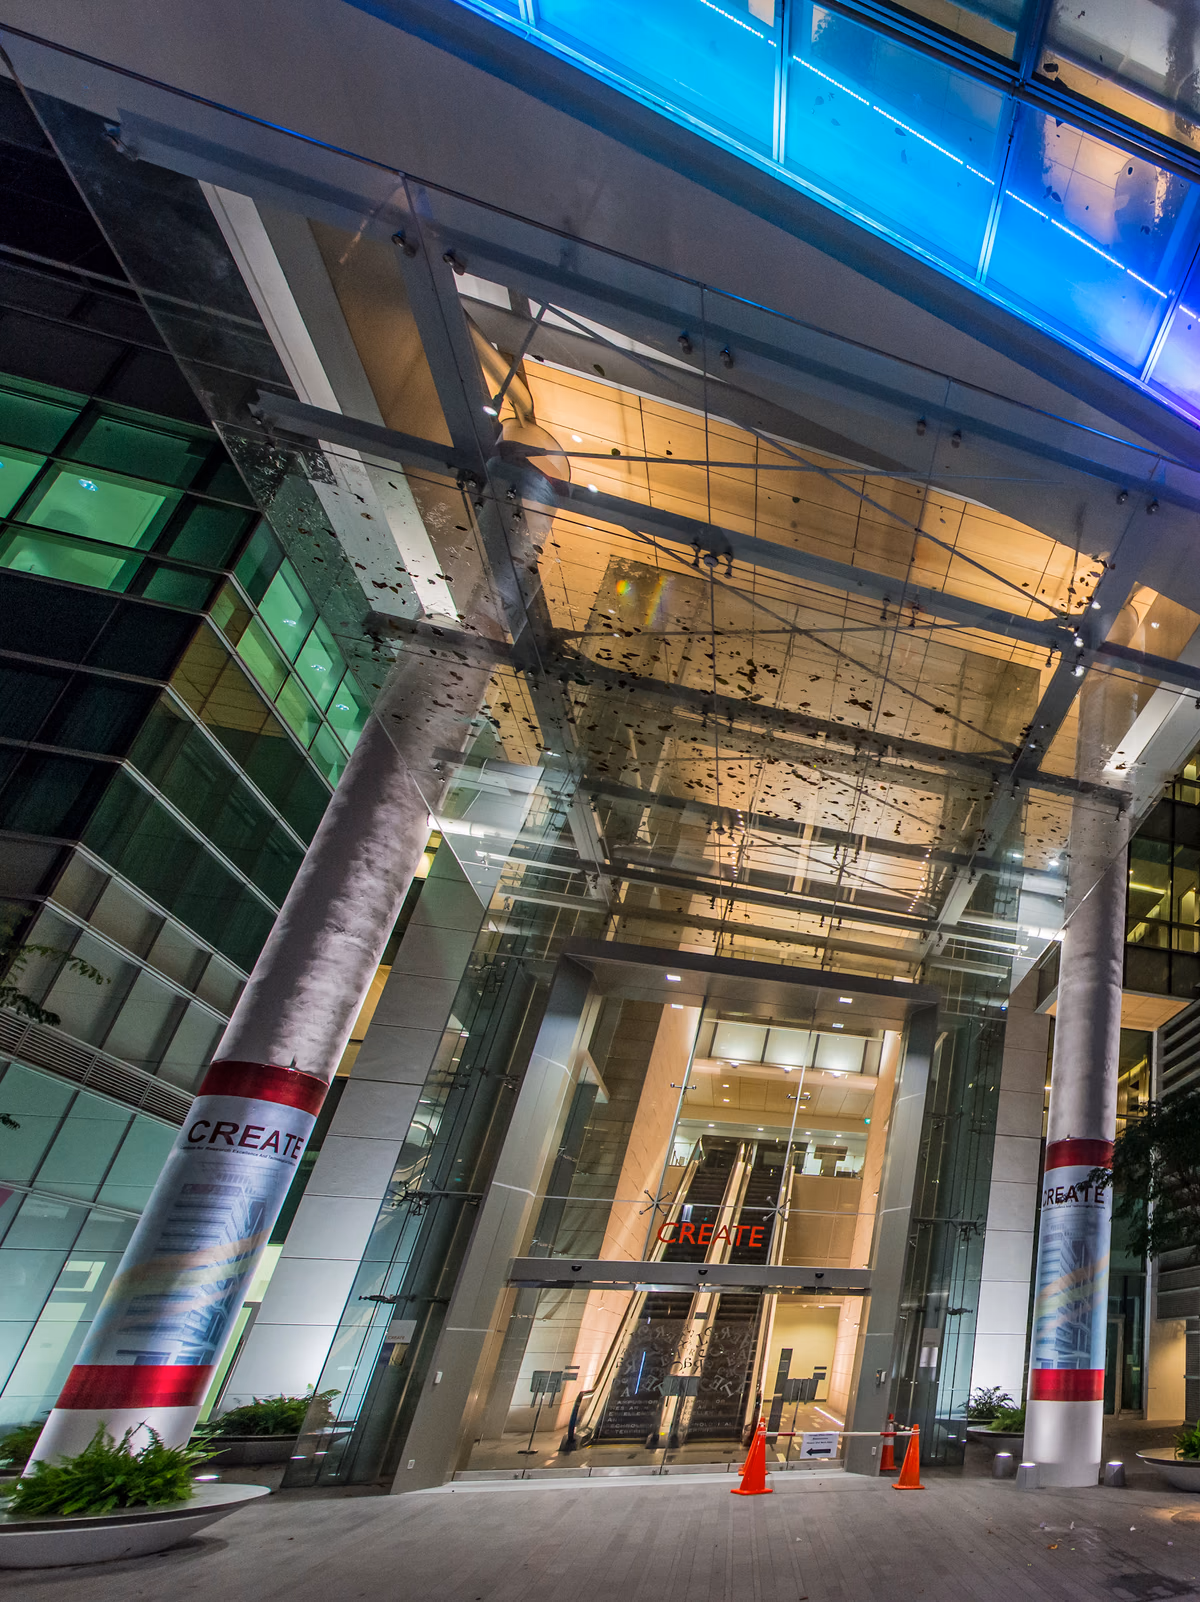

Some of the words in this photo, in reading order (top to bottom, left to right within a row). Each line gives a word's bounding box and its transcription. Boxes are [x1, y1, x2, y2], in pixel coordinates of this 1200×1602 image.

[187, 1120, 304, 1159] CREATE
[1043, 1184, 1105, 1207] CREATE
[657, 1222, 765, 1247] CREATE
